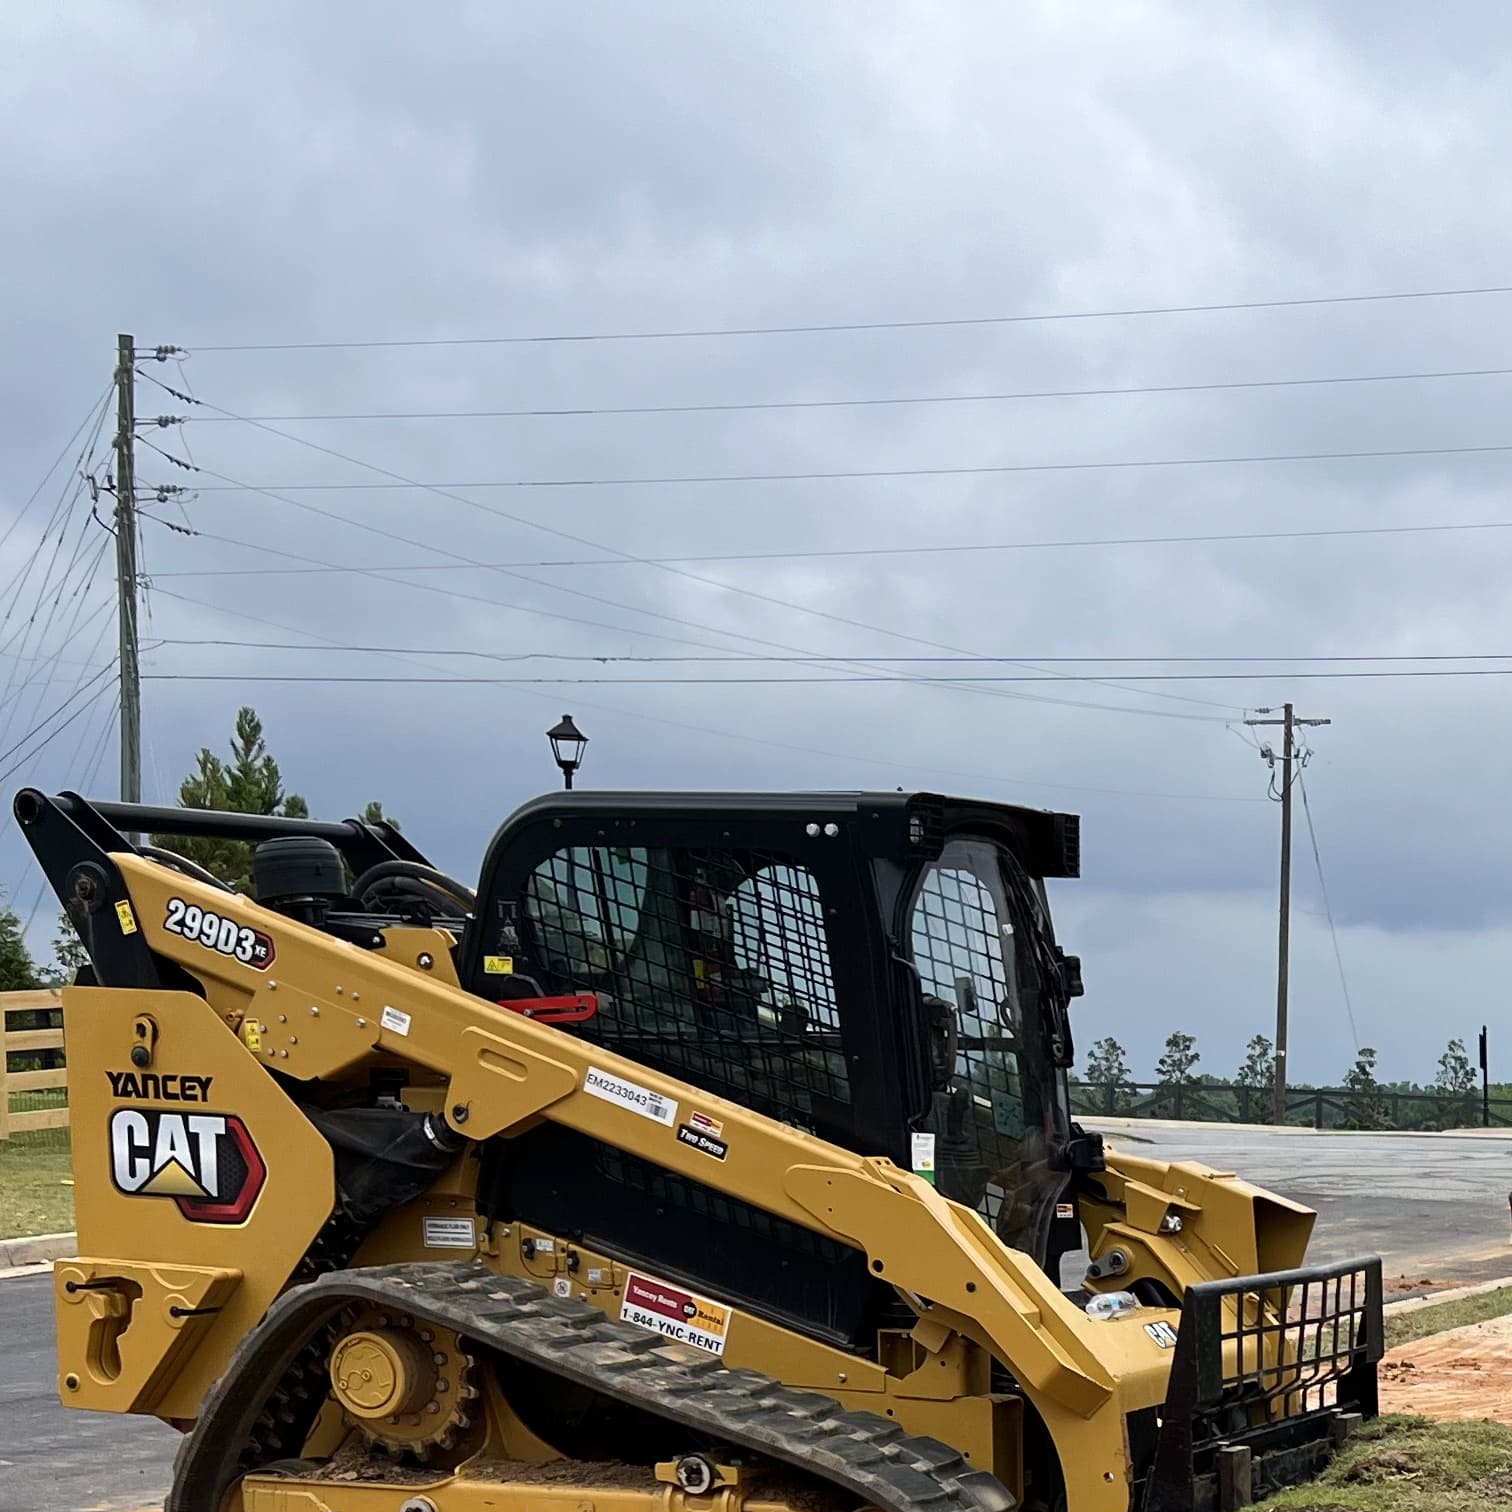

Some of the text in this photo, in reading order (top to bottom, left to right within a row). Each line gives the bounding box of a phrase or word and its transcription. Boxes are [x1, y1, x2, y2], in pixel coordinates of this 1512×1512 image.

[164, 899, 256, 962] 299D3
[104, 1071, 214, 1103] YANCEY
[586, 1073, 648, 1107] EM2233043
[111, 1110, 226, 1198] CAT
[623, 1308, 723, 1353] 1-844-YNC-RENT
[1143, 1320, 1178, 1349] CAT
